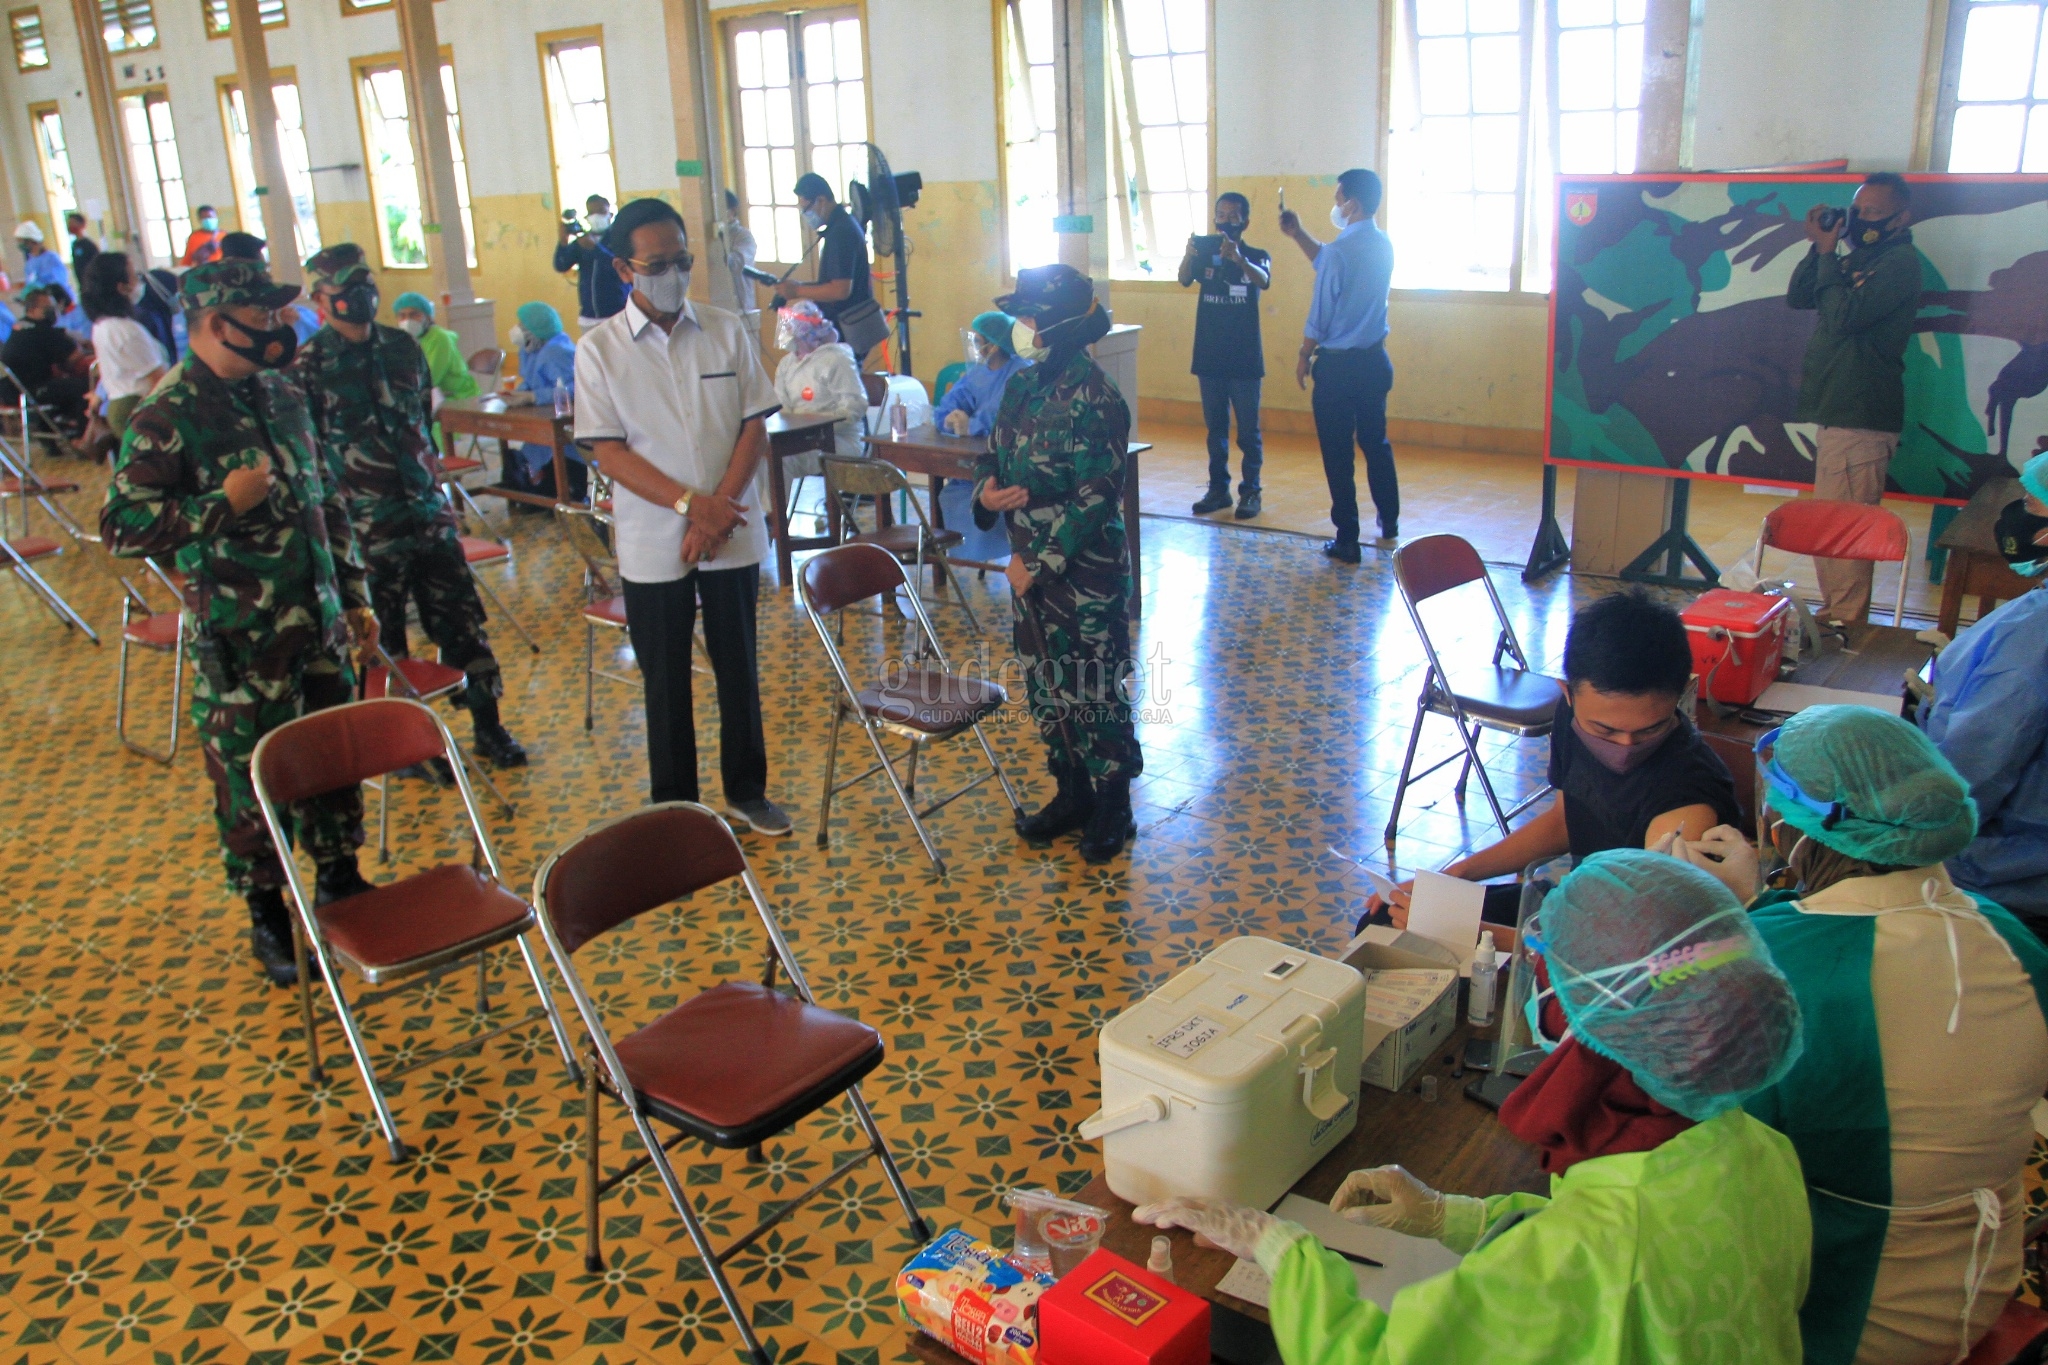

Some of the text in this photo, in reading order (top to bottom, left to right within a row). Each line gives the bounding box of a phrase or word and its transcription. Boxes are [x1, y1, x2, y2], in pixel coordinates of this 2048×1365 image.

[1203, 294, 1247, 305] BREGADA
[1157, 1016, 1203, 1048] IFRS DKT
[1183, 1027, 1219, 1053] JOGJA
[1050, 1215, 1092, 1235] Vit
